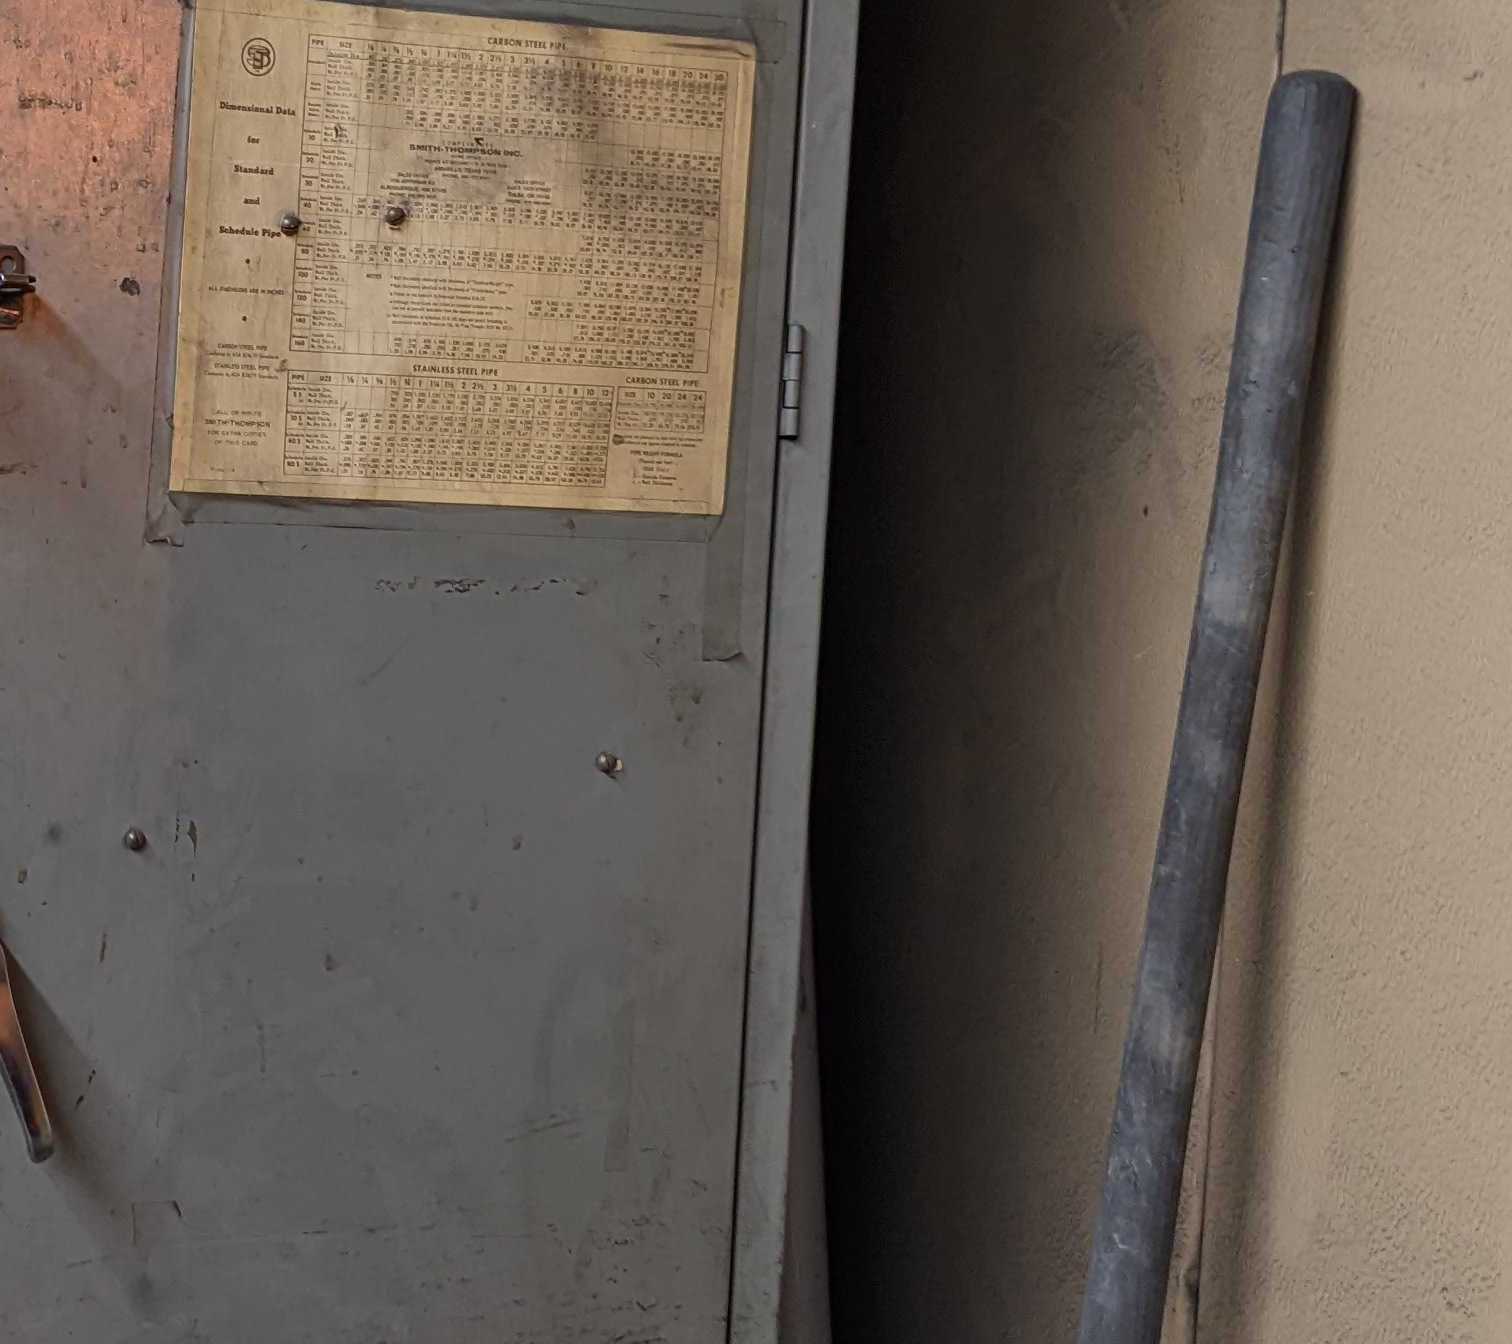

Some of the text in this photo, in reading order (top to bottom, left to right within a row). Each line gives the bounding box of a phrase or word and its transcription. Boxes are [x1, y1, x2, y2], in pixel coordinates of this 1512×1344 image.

[487, 37, 566, 51] CARBON STEEL PIPE
[220, 101, 296, 117] Dimensional Data
[247, 136, 260, 144] for
[234, 165, 274, 176] Standard
[244, 197, 260, 205] and
[219, 226, 281, 239] Schedule Pipe
[413, 364, 498, 377] STAINLESS STEEL PIPE
[626, 376, 699, 387] CARBON STEEL PIPE
